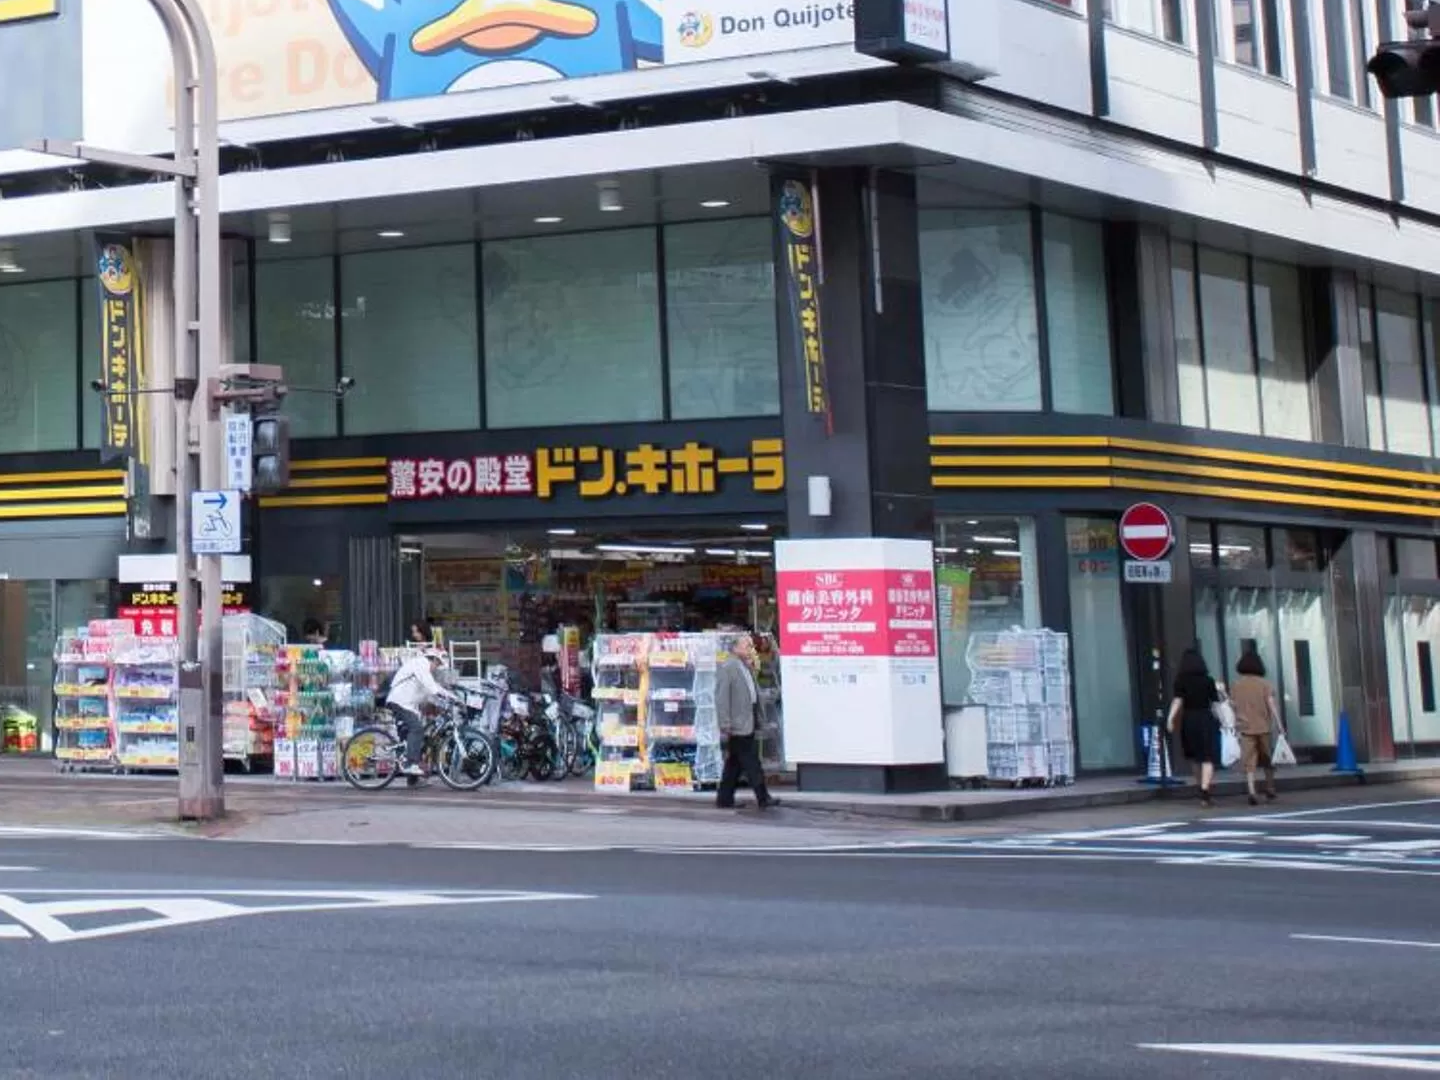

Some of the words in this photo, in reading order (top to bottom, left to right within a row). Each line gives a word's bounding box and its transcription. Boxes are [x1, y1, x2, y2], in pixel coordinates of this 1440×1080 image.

[720, 12, 766, 36] Don
[773, 1, 857, 30] Quijote
[390, 454, 533, 498] 驚安の殿堂
[801, 606, 862, 621] クリニック
